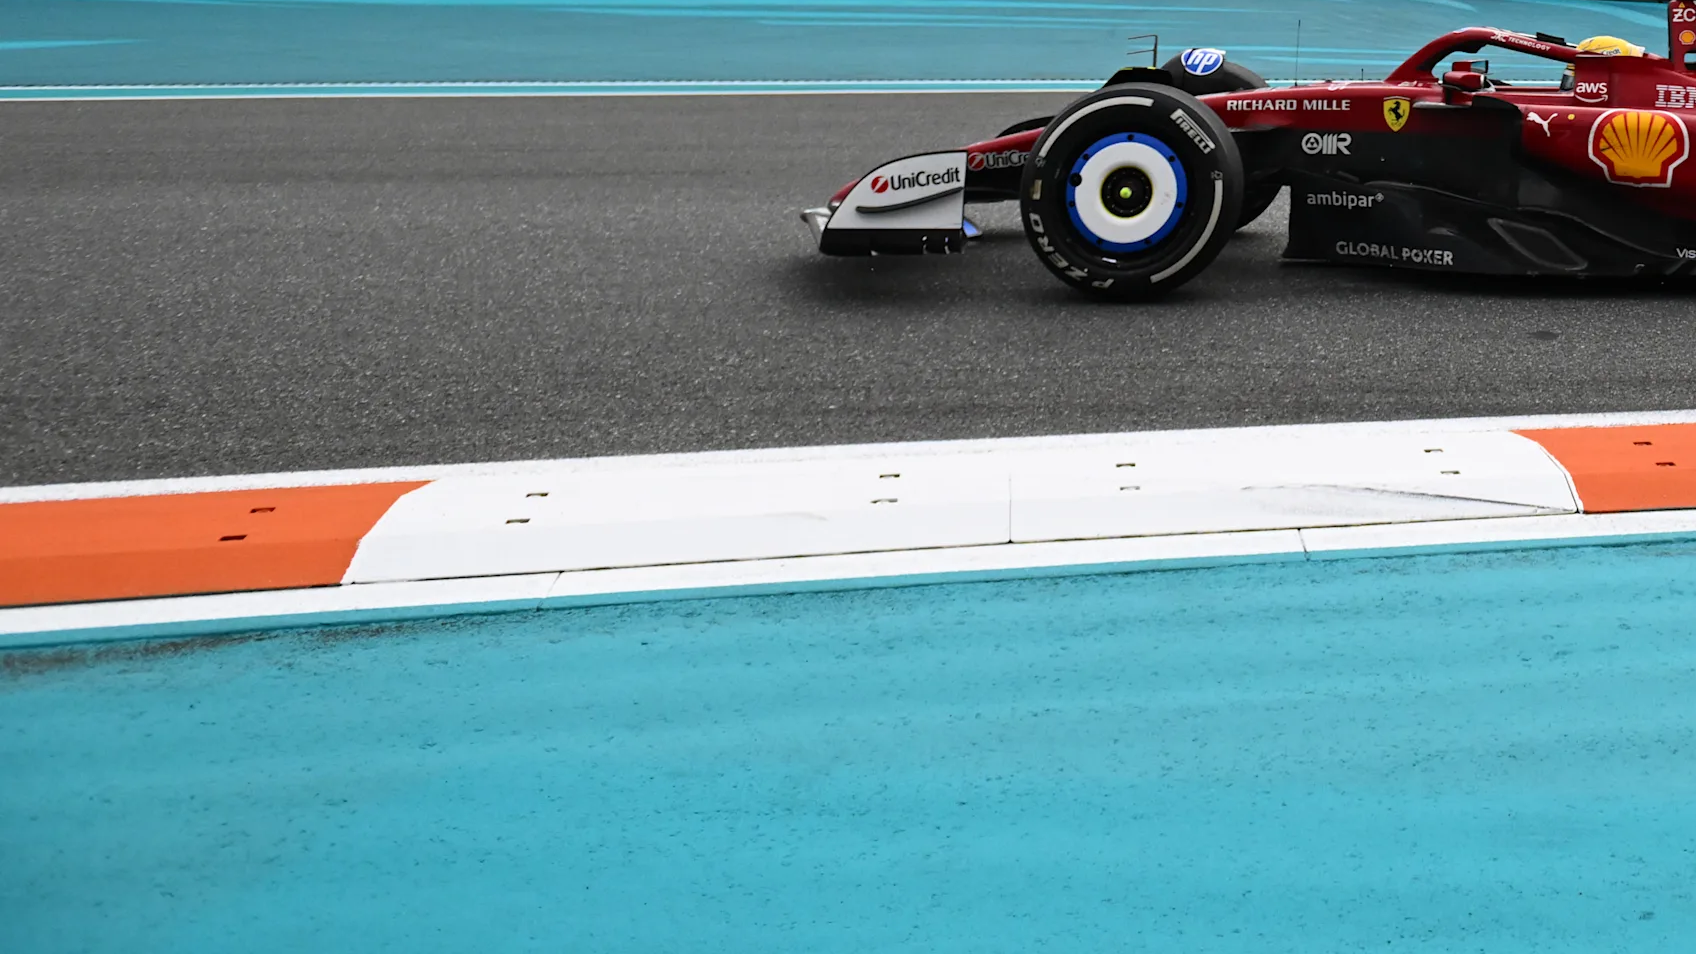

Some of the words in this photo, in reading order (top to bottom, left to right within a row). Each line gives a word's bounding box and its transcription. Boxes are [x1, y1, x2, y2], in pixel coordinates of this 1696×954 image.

[1508, 36, 1551, 51] TECHNOLOGY
[1186, 48, 1219, 75] hp
[1575, 82, 1608, 94] aws
[1226, 99, 1297, 112] RICHARD
[1303, 99, 1350, 112] MILLE
[1170, 108, 1215, 154] PIRELLI
[985, 150, 1031, 168] UniCre
[890, 167, 960, 191] UniCredit
[1336, 241, 1398, 260] GLOBAL
[1402, 247, 1453, 266] POKER
